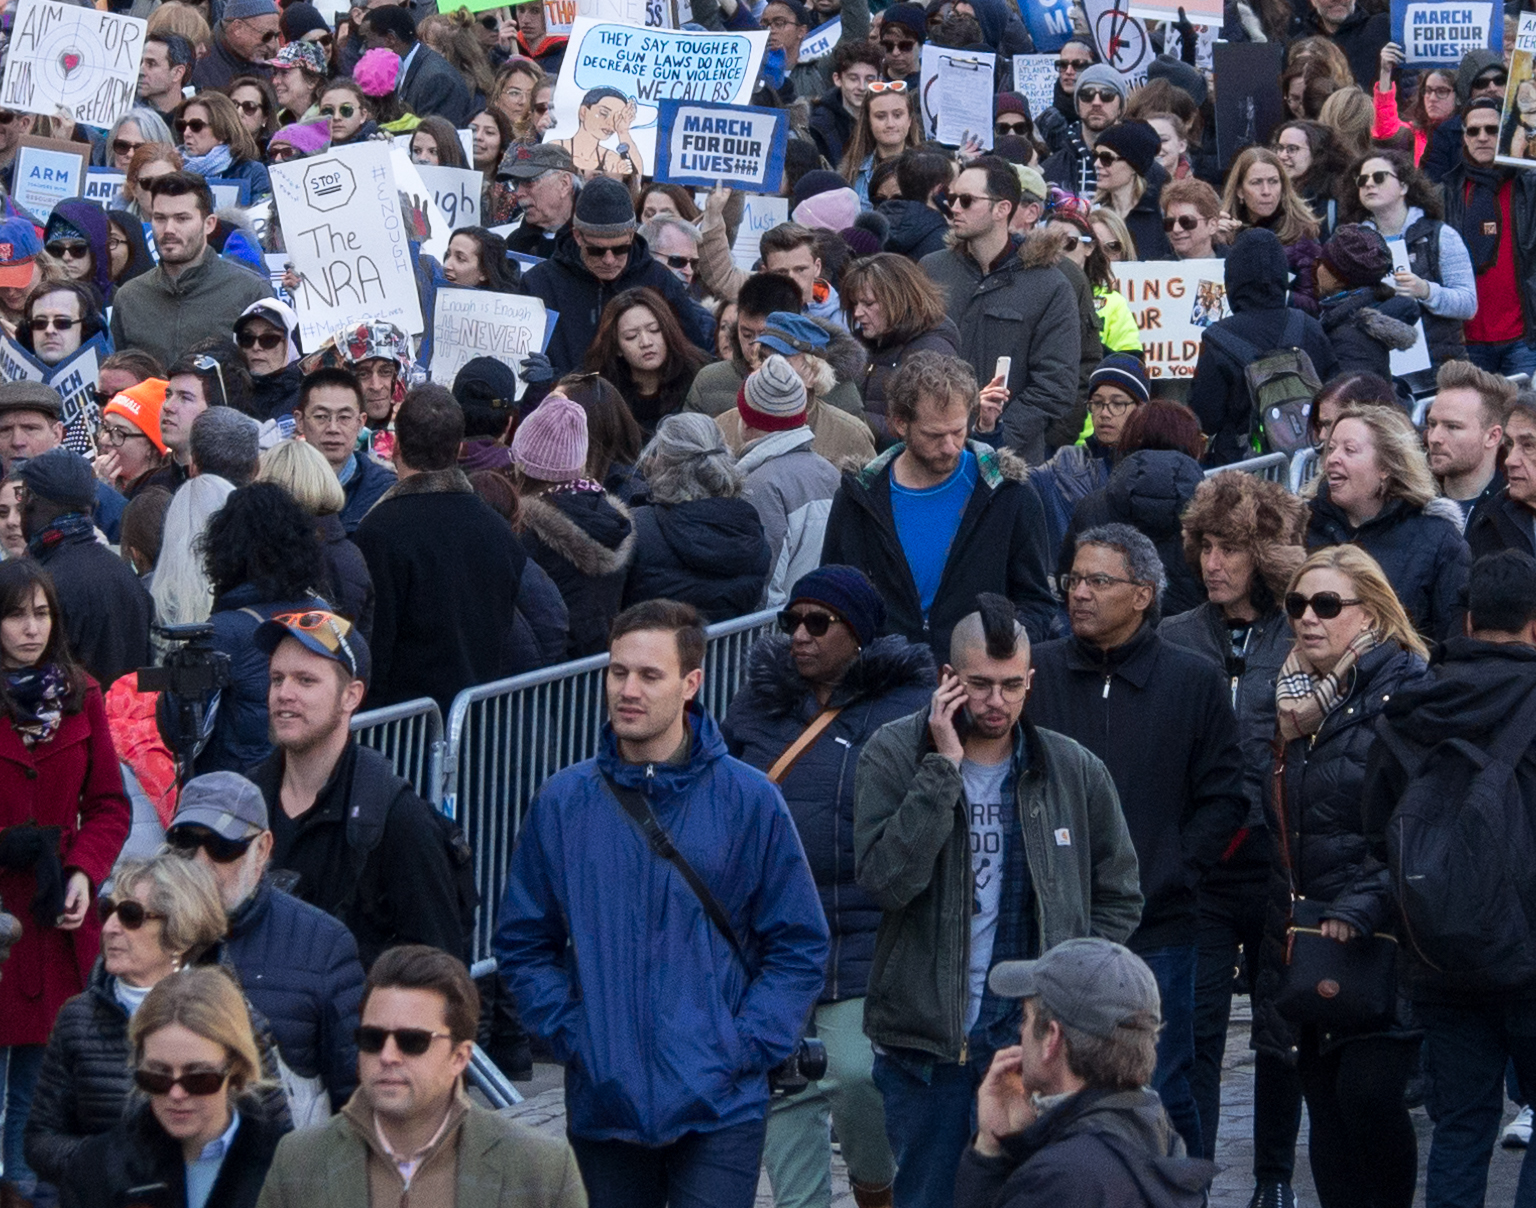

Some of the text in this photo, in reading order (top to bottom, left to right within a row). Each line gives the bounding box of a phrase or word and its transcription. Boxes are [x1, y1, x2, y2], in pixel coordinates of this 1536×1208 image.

[1413, 9, 1474, 25] MARCH
[20, 7, 141, 69] AIM FOR
[597, 30, 739, 55] THEY SAY TOUGHER
[1413, 25, 1483, 42] FOR OUR
[1414, 42, 1460, 58] LIVES
[582, 54, 742, 81] DECREASE GUN VIOLENCE
[653, 54, 743, 70] LAWS NOT
[7, 59, 137, 128] GUN REFORM
[683, 115, 752, 137] MARCH
[29, 165, 69, 184] ARM
[681, 154, 734, 173] LIVES
[310, 172, 341, 189] STOP
[298, 223, 362, 259] The
[300, 255, 386, 311] NRA
[480, 298, 532, 320] is Enough
[434, 314, 533, 359] #NEVER
